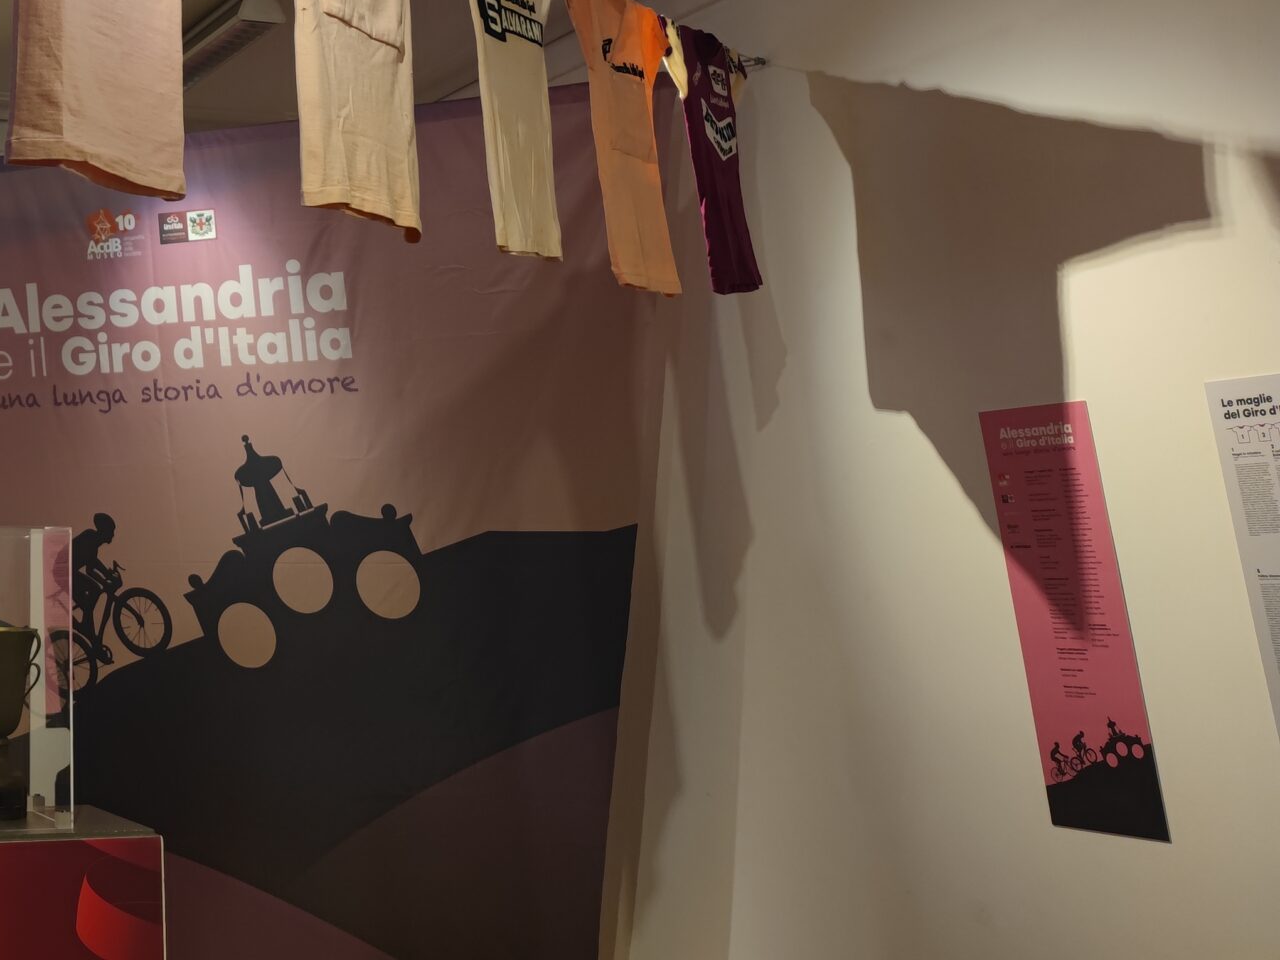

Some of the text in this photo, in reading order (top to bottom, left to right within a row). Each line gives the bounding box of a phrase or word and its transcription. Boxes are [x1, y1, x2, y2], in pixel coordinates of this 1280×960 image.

[115, 214, 136, 231] 10
[28, 336, 47, 377] il
[61, 331, 161, 375] Giro
[173, 317, 352, 369] d'Italia
[52, 384, 128, 414] lunga
[141, 378, 222, 402] storia
[236, 371, 359, 396] d'amore
[1221, 393, 1273, 408] Le maglie
[1223, 409, 1240, 420] del
[1242, 407, 1267, 418] Giro
[1000, 422, 1072, 439] Alessandria
[1016, 438, 1037, 448] Giro
